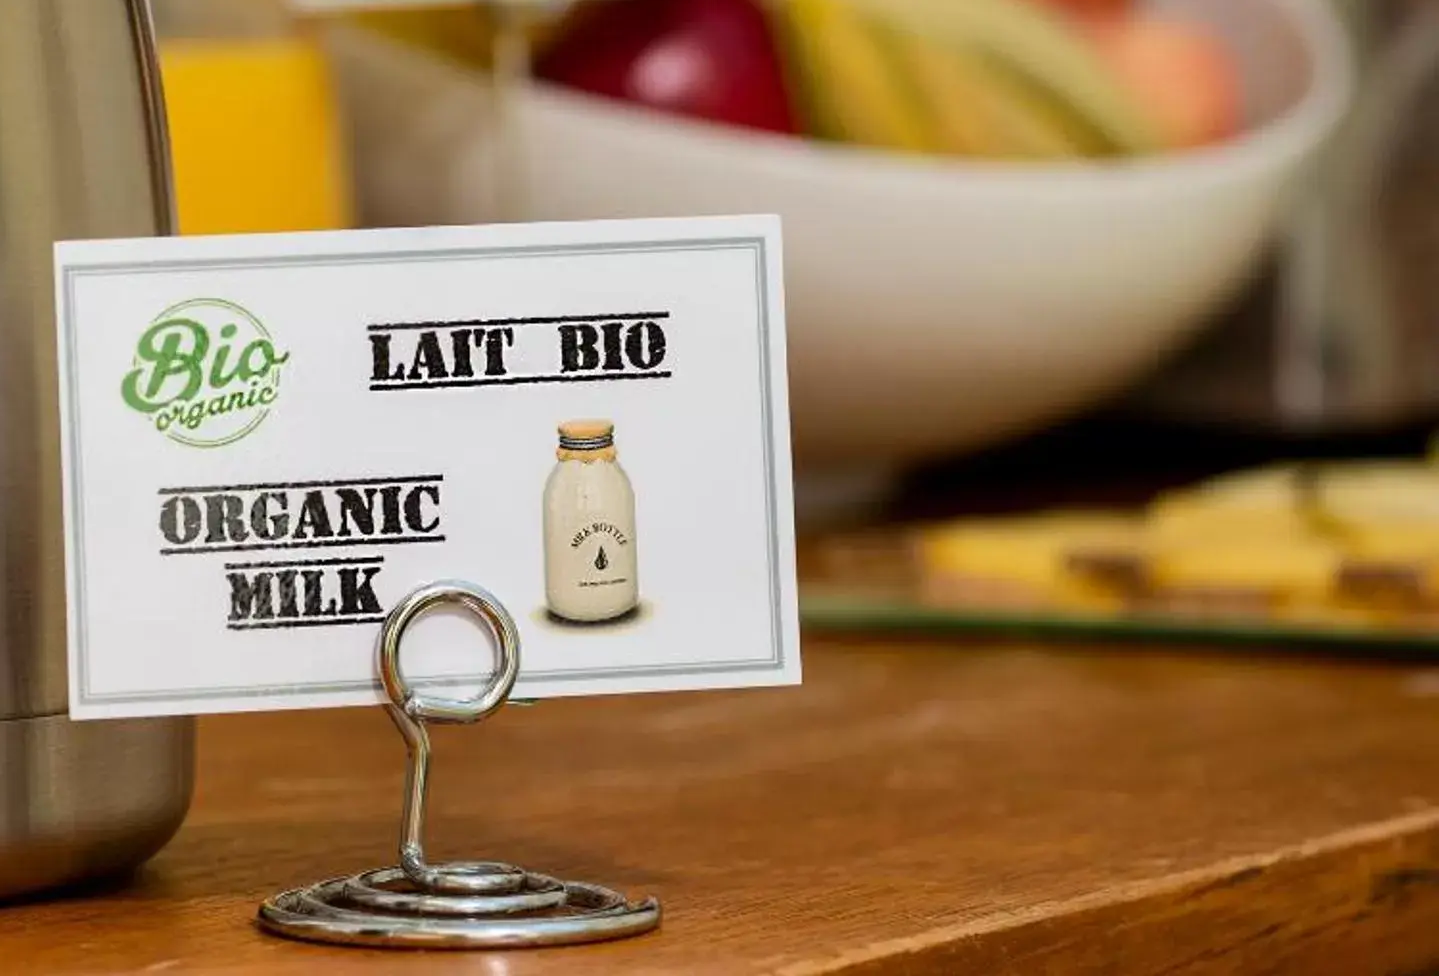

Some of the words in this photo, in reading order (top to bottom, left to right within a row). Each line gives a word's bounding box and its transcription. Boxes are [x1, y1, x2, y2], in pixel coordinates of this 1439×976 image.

[121, 317, 290, 413] Bio
[368, 325, 514, 381] LAIT
[557, 320, 667, 374] BIO
[156, 380, 279, 432] organic
[159, 485, 440, 545] ORGANIC
[225, 566, 384, 622] MILK
